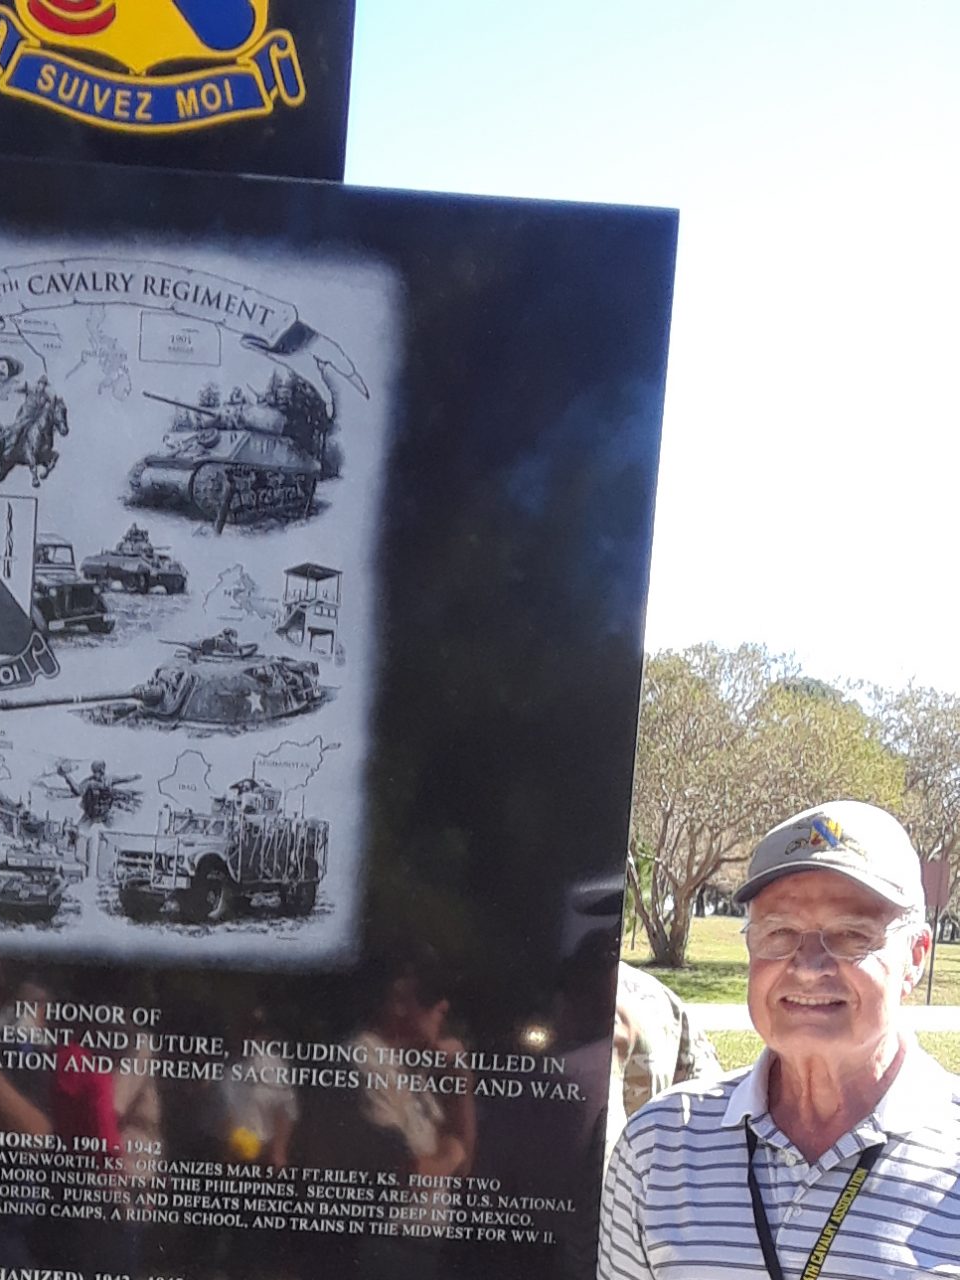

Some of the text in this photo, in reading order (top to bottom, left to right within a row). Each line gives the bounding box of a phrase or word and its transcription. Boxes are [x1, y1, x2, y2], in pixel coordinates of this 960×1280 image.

[37, 65, 233, 120] SUIVEZ MOI
[28, 272, 133, 296] CAVALRY
[144, 275, 274, 326] REGIMENT
[15, 999, 161, 1026] IN HONOR OF
[80, 1028, 128, 1051] AND
[136, 1031, 228, 1056] FUTURE,
[242, 1037, 367, 1064] INCLUDING
[374, 1045, 446, 1069] THOSE
[454, 1050, 535, 1074] KILLED
[542, 1054, 564, 1076] IN
[64, 1052, 112, 1075] AND
[119, 1056, 224, 1081] SUPREME
[231, 1062, 359, 1089] SACRIFICES
[366, 1070, 388, 1091] IN
[393, 1071, 467, 1095] PEACE
[474, 1076, 522, 1098] AND
[530, 1079, 586, 1102] WAR.
[73, 1135, 106, 1152] 1901
[127, 1139, 161, 1155] 1942
[63, 1187, 130, 1204] PURSUES
[134, 1191, 168, 1206] AND
[172, 1193, 239, 1210] DEFEATS
[243, 1197, 314, 1214] MEXICAN
[319, 1202, 384, 1218] BANDITS
[388, 1205, 426, 1220] DEEP
[430, 1208, 467, 1223] INTO
[811, 1223, 838, 1264] CAVALRY
[831, 1167, 869, 1223] ASSOCIATION
